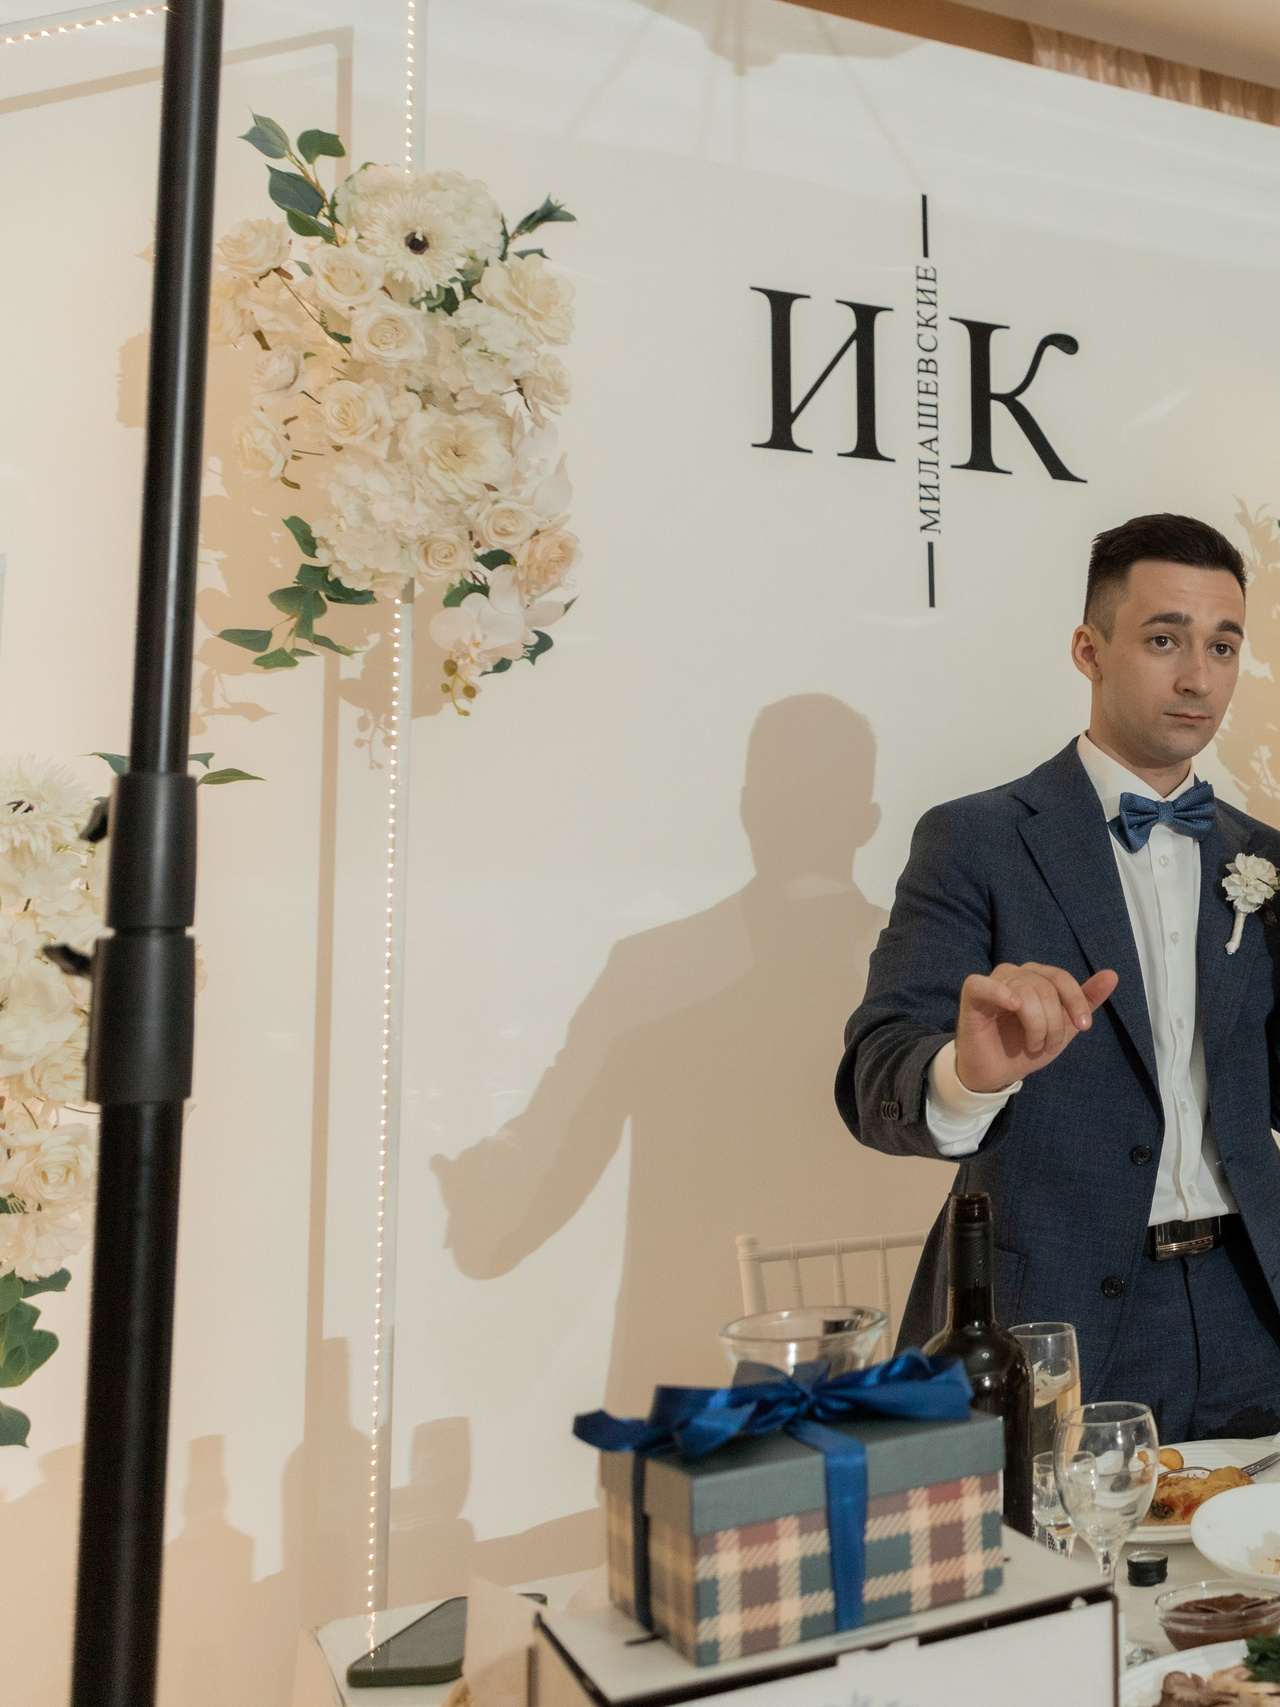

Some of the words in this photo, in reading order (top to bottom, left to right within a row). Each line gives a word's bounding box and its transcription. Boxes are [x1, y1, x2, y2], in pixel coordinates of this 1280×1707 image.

[750, 286, 895, 462] И
[948, 316, 1088, 484] К
[915, 264, 941, 534] МИЛАШЕВСКИЕ
